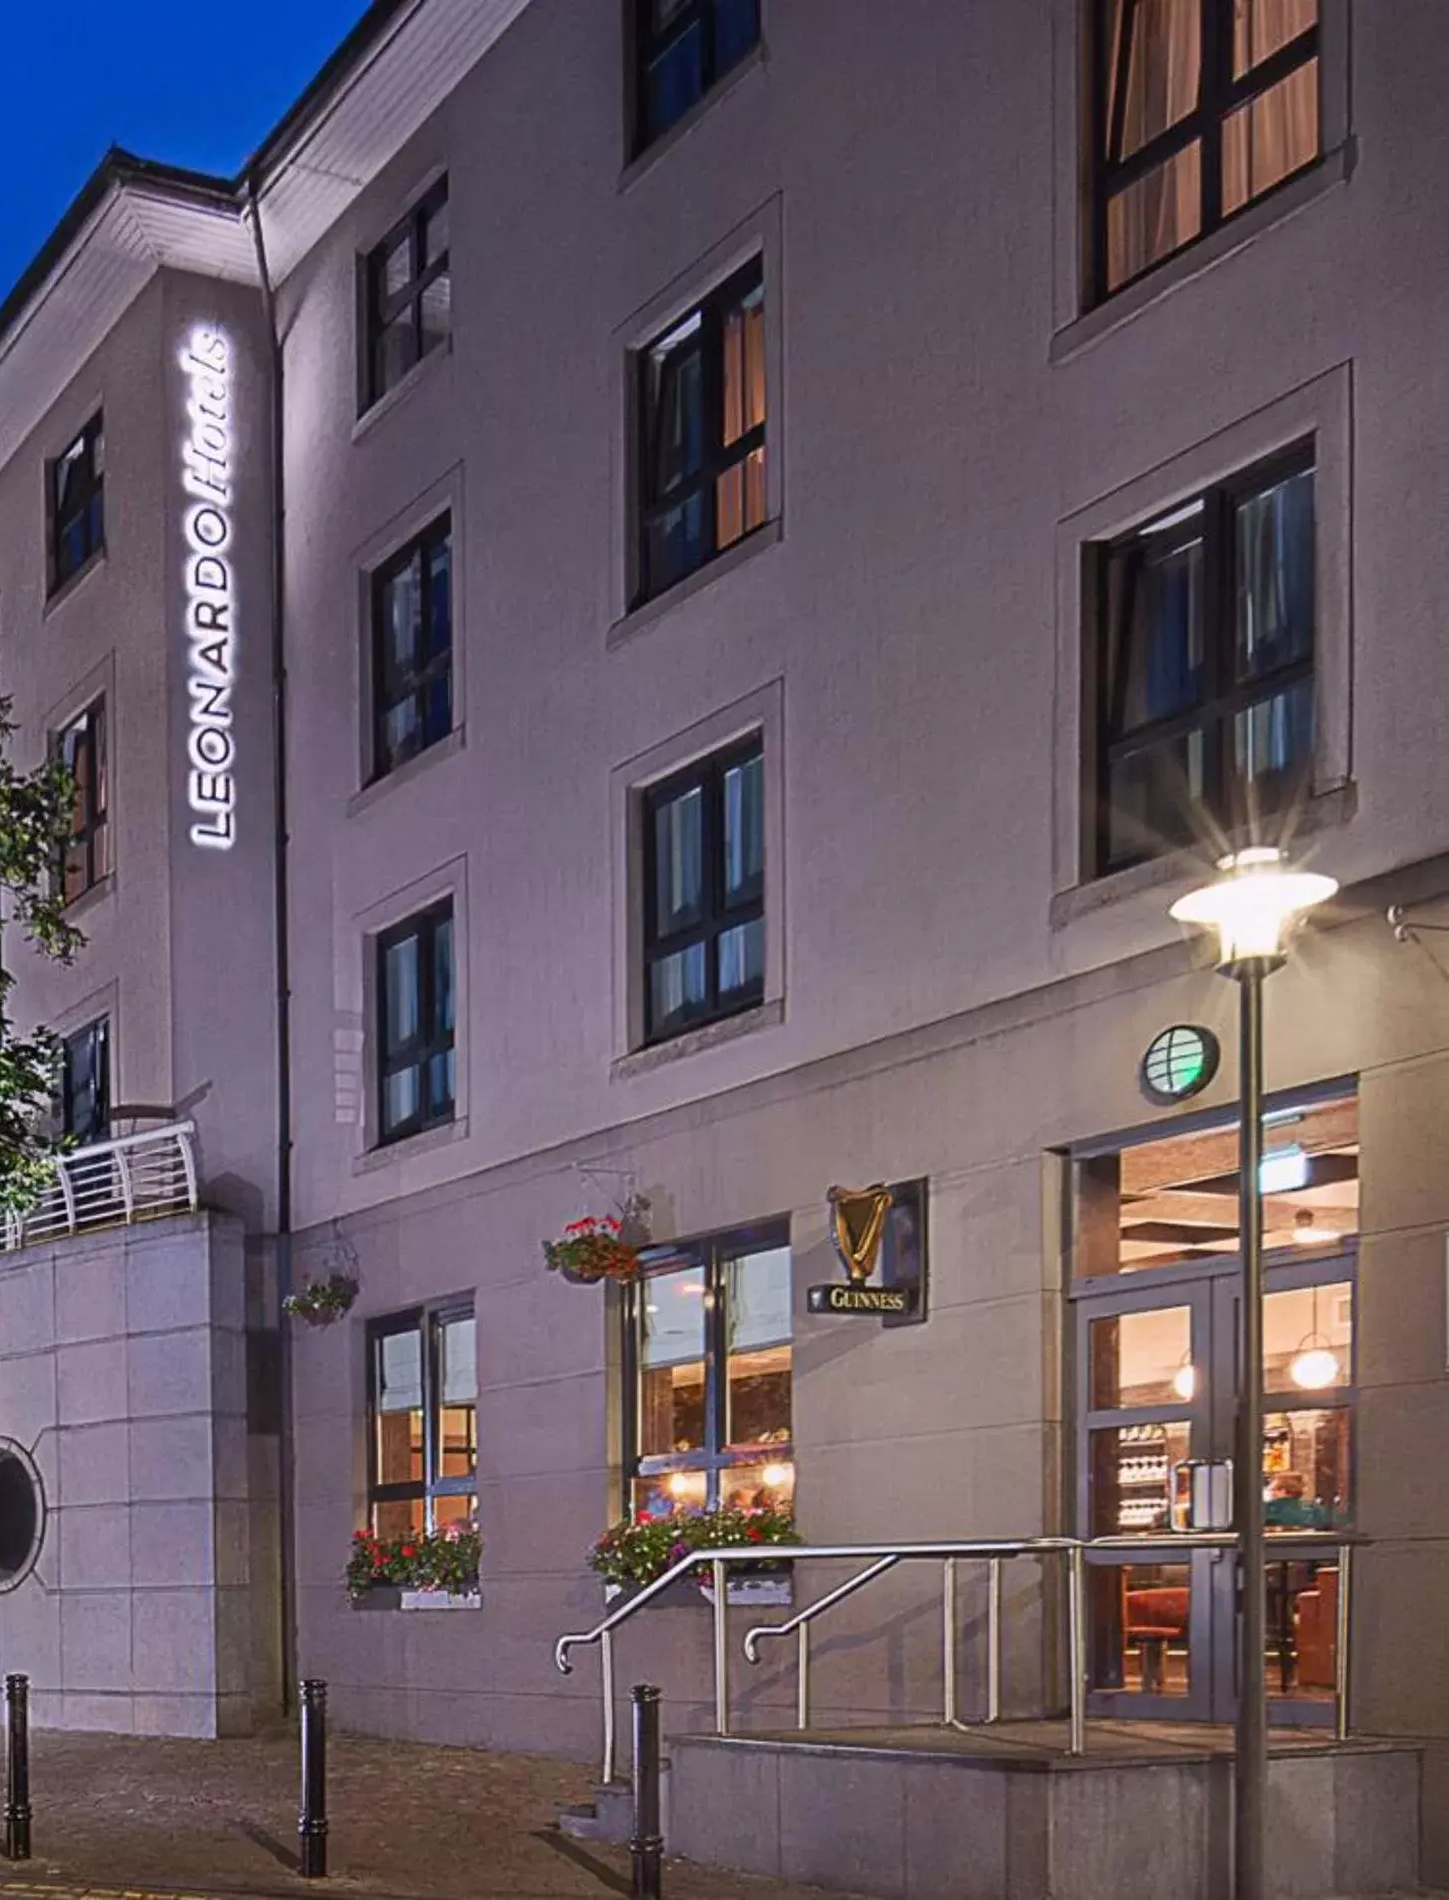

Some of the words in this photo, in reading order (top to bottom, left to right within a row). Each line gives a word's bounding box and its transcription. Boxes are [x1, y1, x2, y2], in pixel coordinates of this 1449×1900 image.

[188, 331, 228, 497] Hotels
[193, 507, 232, 839] LEONARDO
[830, 1287, 904, 1310] GUINNESS
